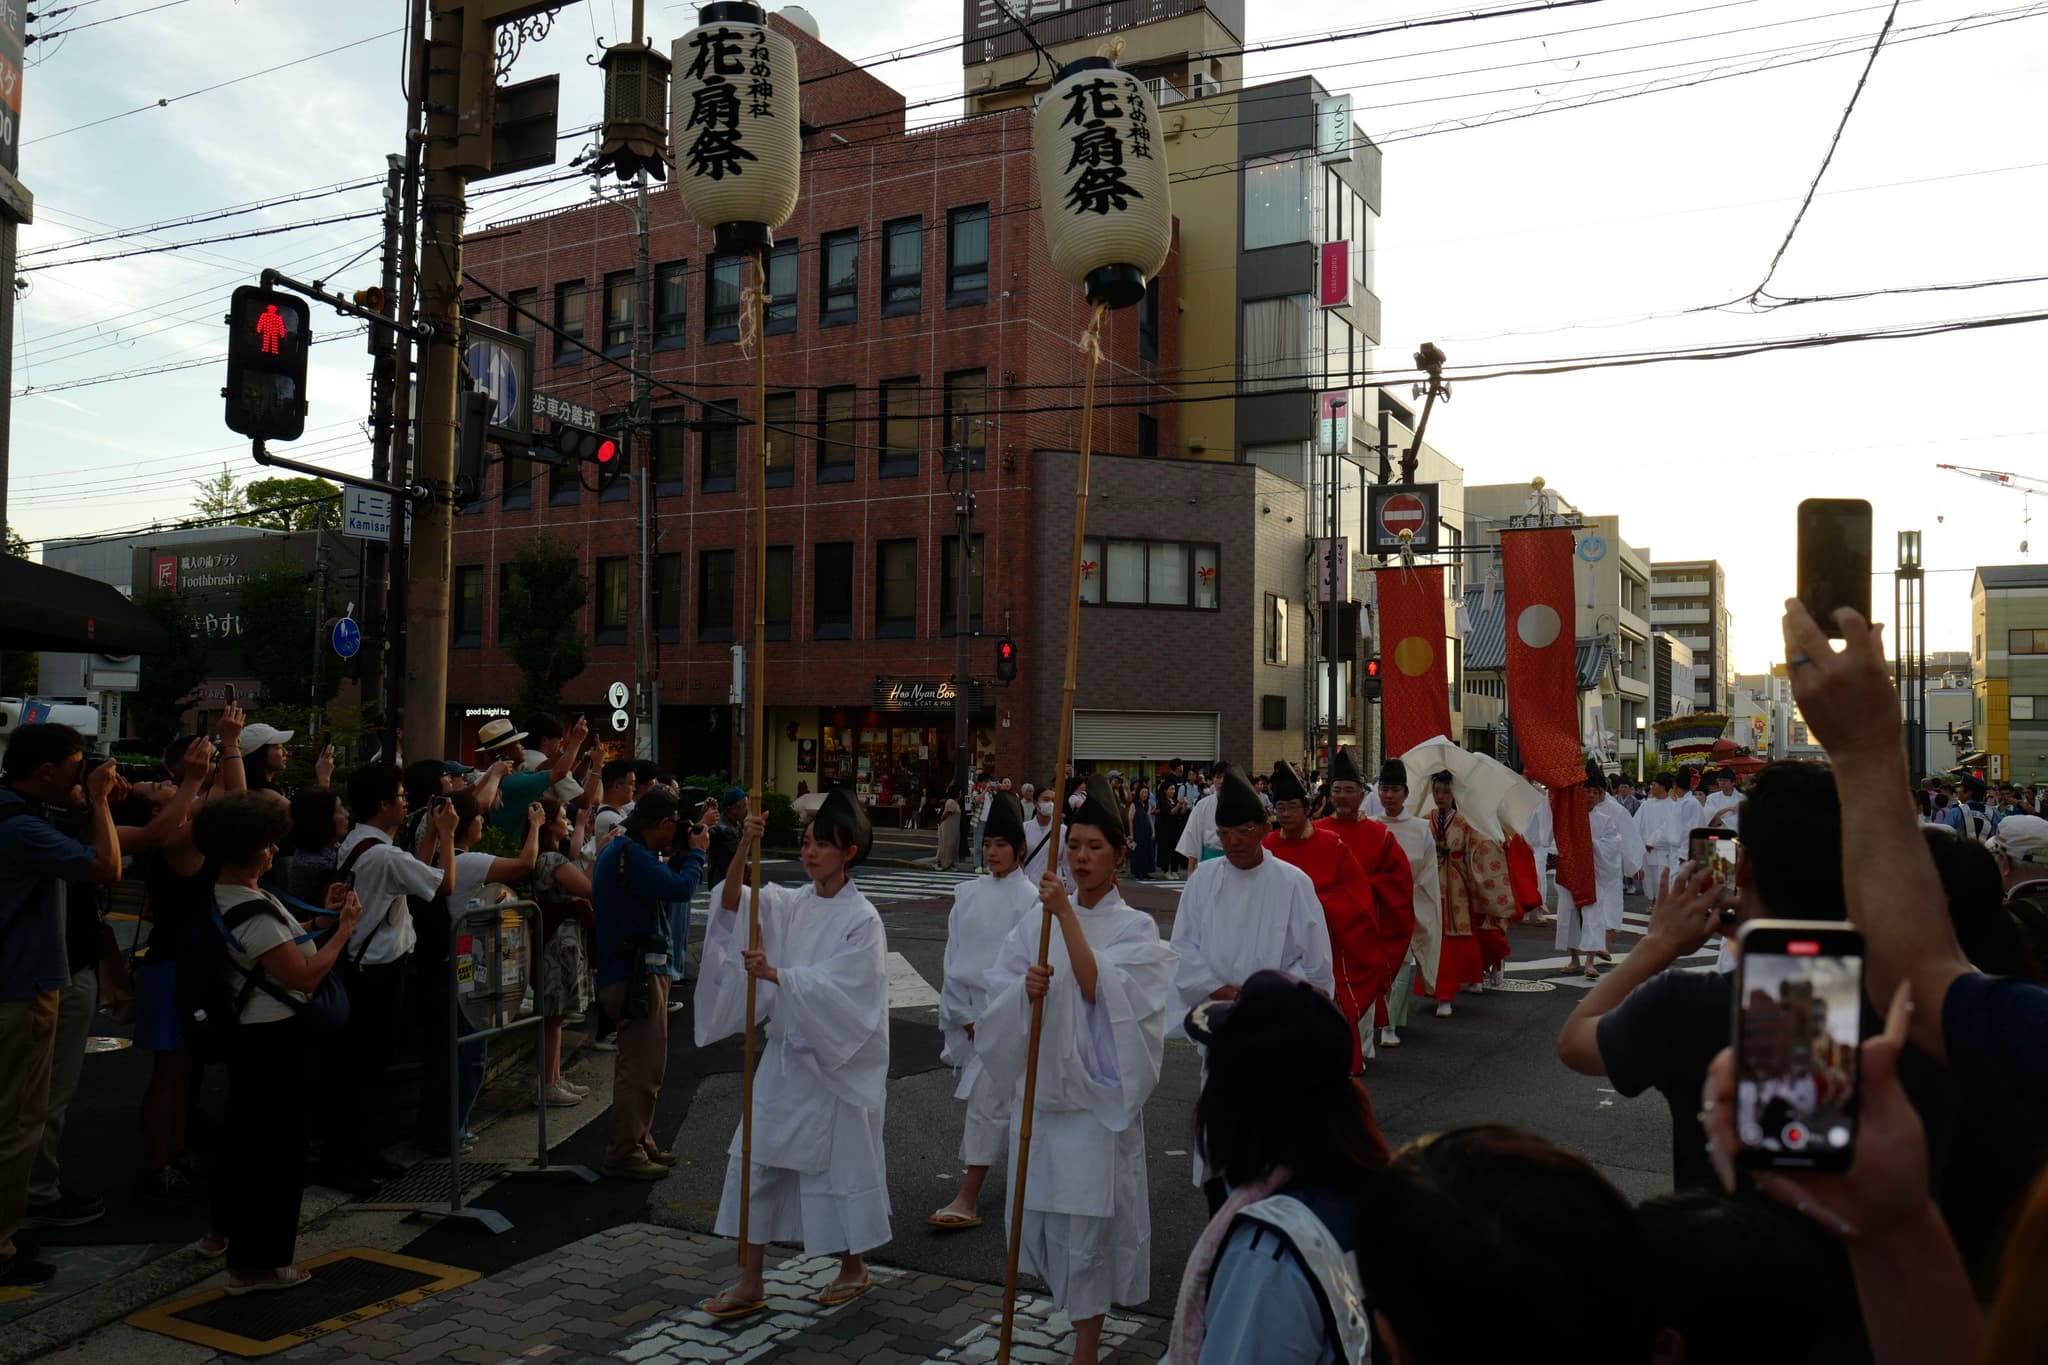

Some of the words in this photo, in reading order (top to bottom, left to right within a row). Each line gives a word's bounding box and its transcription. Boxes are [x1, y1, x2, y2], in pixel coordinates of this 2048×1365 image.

[685, 27, 758, 181] 花扇祭
[747, 27, 774, 118] うねめ神社
[1059, 78, 1143, 215] 花扇祭
[1125, 77, 1153, 160] うねめ神社
[532, 393, 596, 429] 歩車分離式
[181, 573, 235, 588] Toothbrush
